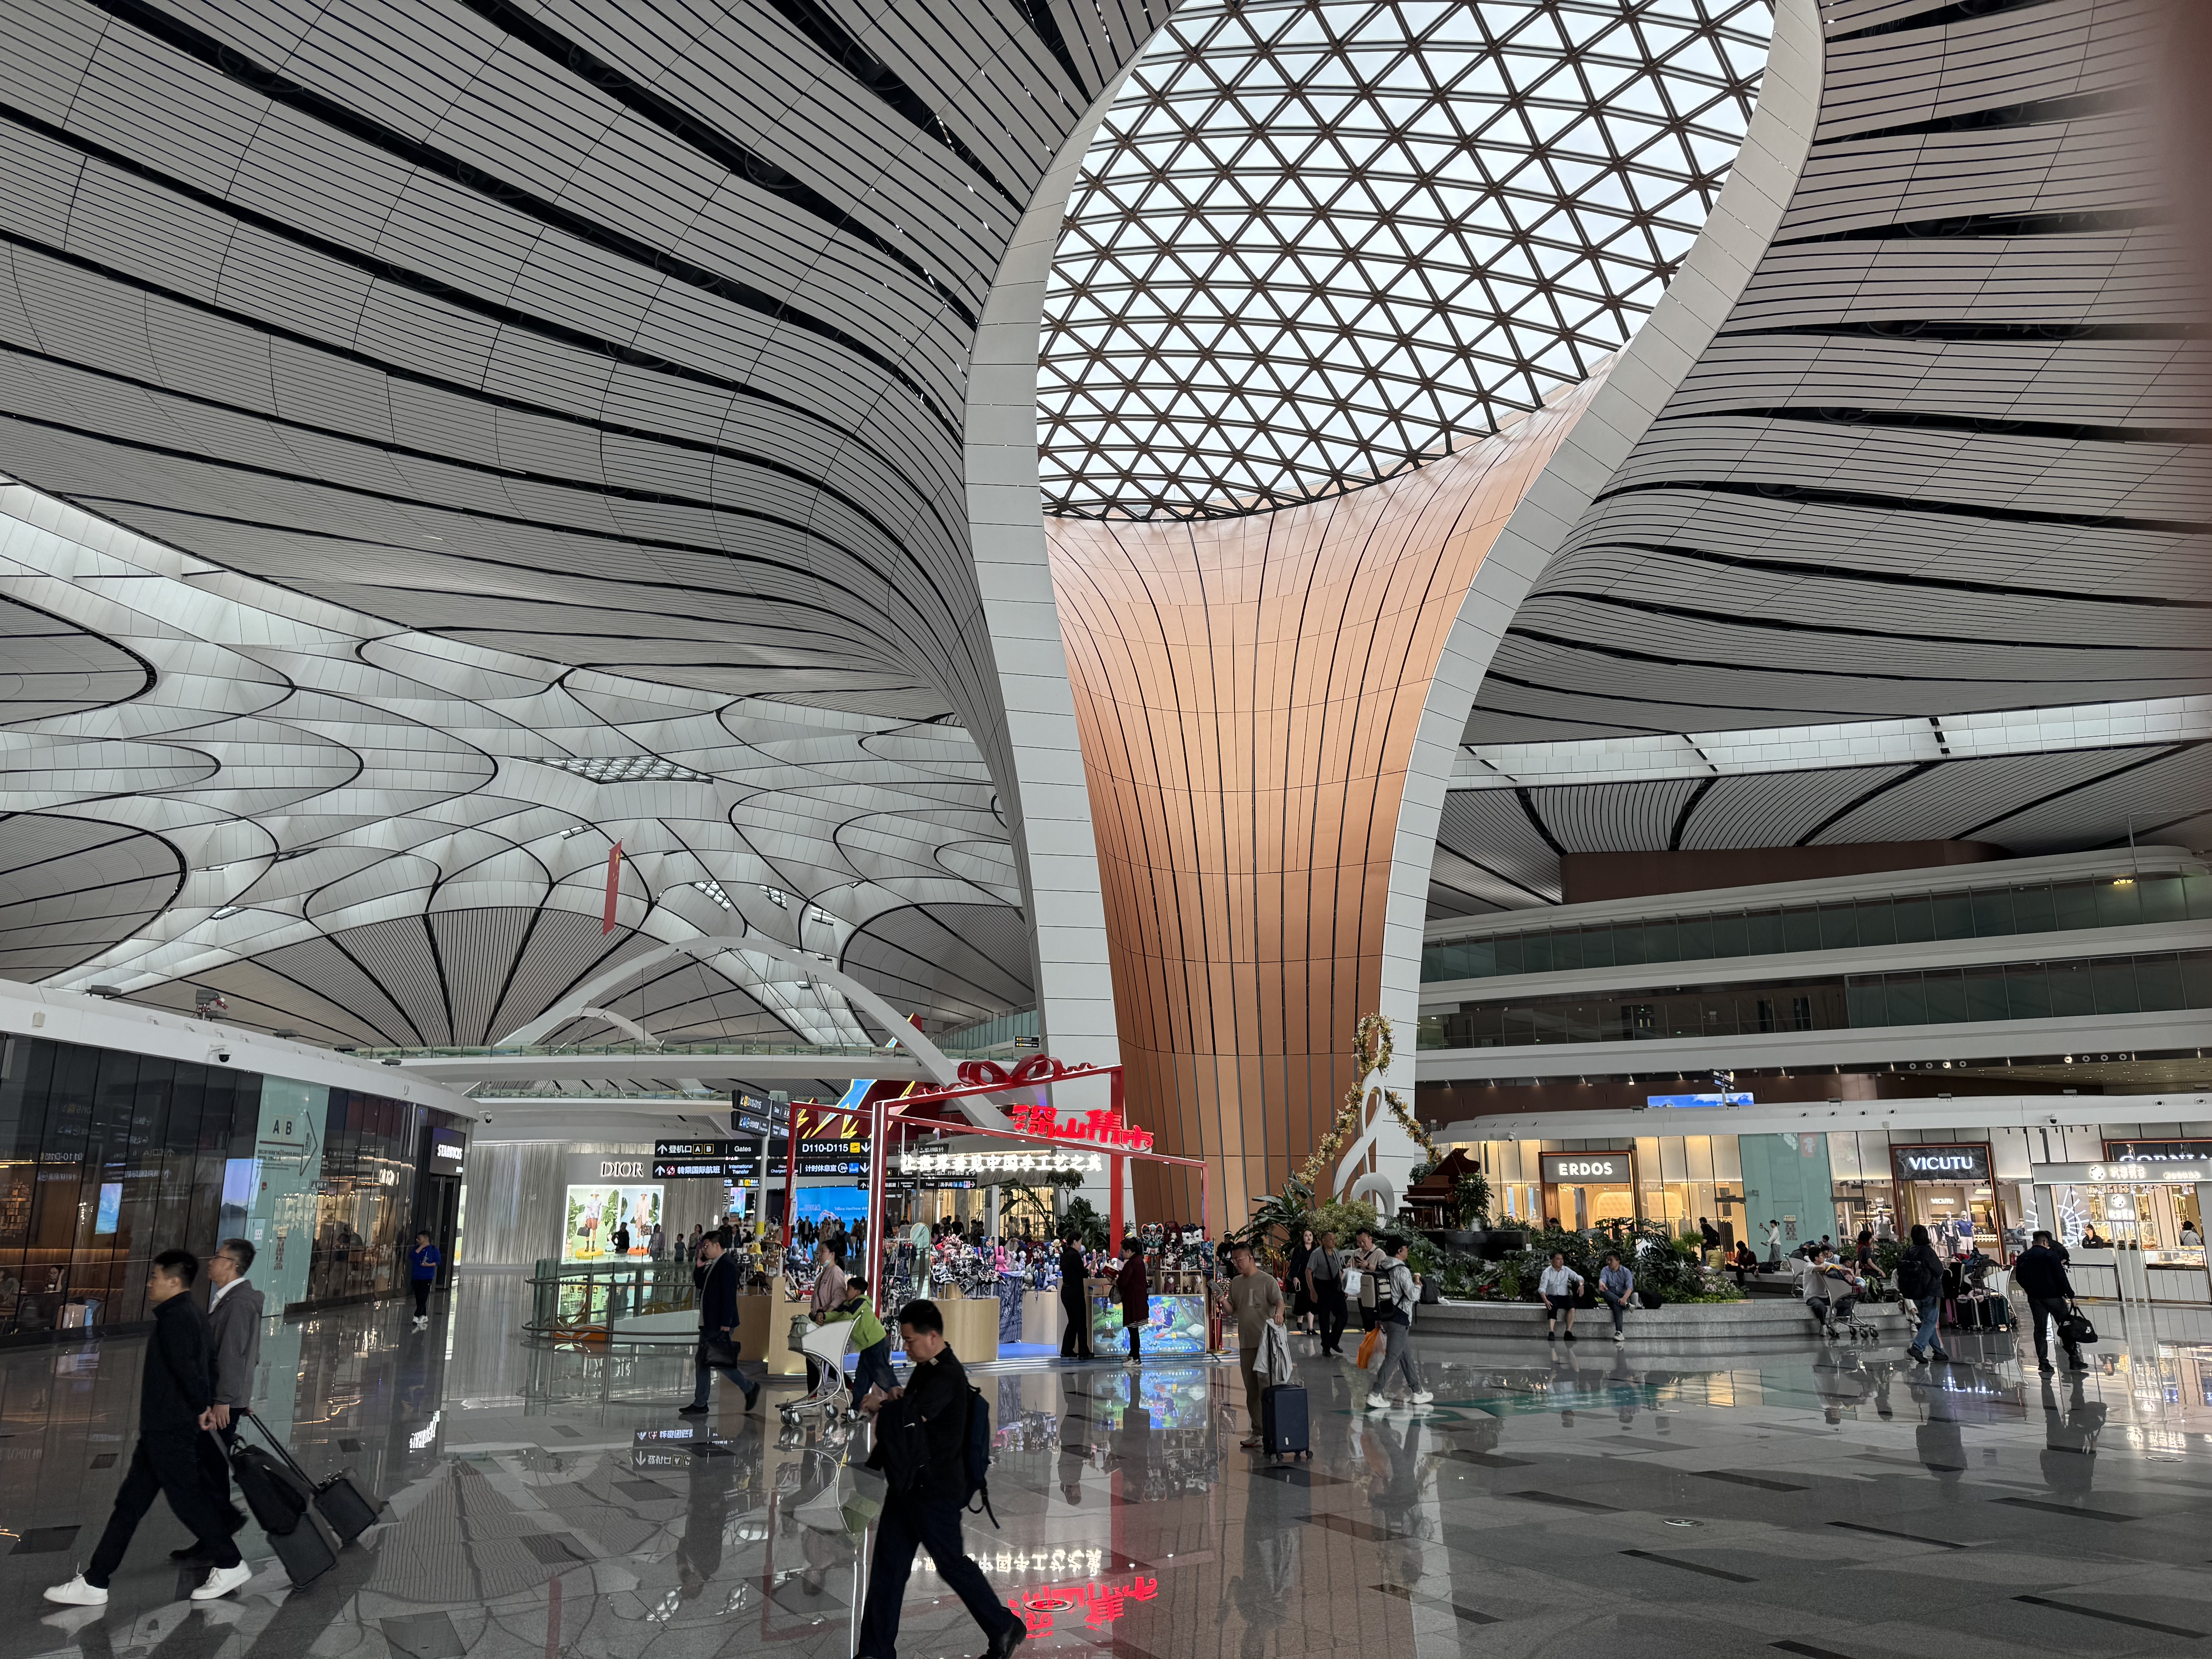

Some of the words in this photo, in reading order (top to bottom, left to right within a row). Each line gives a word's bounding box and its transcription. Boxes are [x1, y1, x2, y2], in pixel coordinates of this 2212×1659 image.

[273, 1120, 279, 1134] A
[286, 1121, 292, 1135] B
[1012, 1104, 1154, 1149] 深山集市
[437, 1144, 463, 1160] STARBUCKS
[669, 1145, 692, 1154] 登机口
[802, 1144, 848, 1152] D110-D115
[600, 1162, 644, 1177] DIOR
[677, 1166, 721, 1174] 转乘国际航班
[1559, 1162, 1613, 1176] ERDOS
[1909, 1156, 1973, 1170] VICUTU
